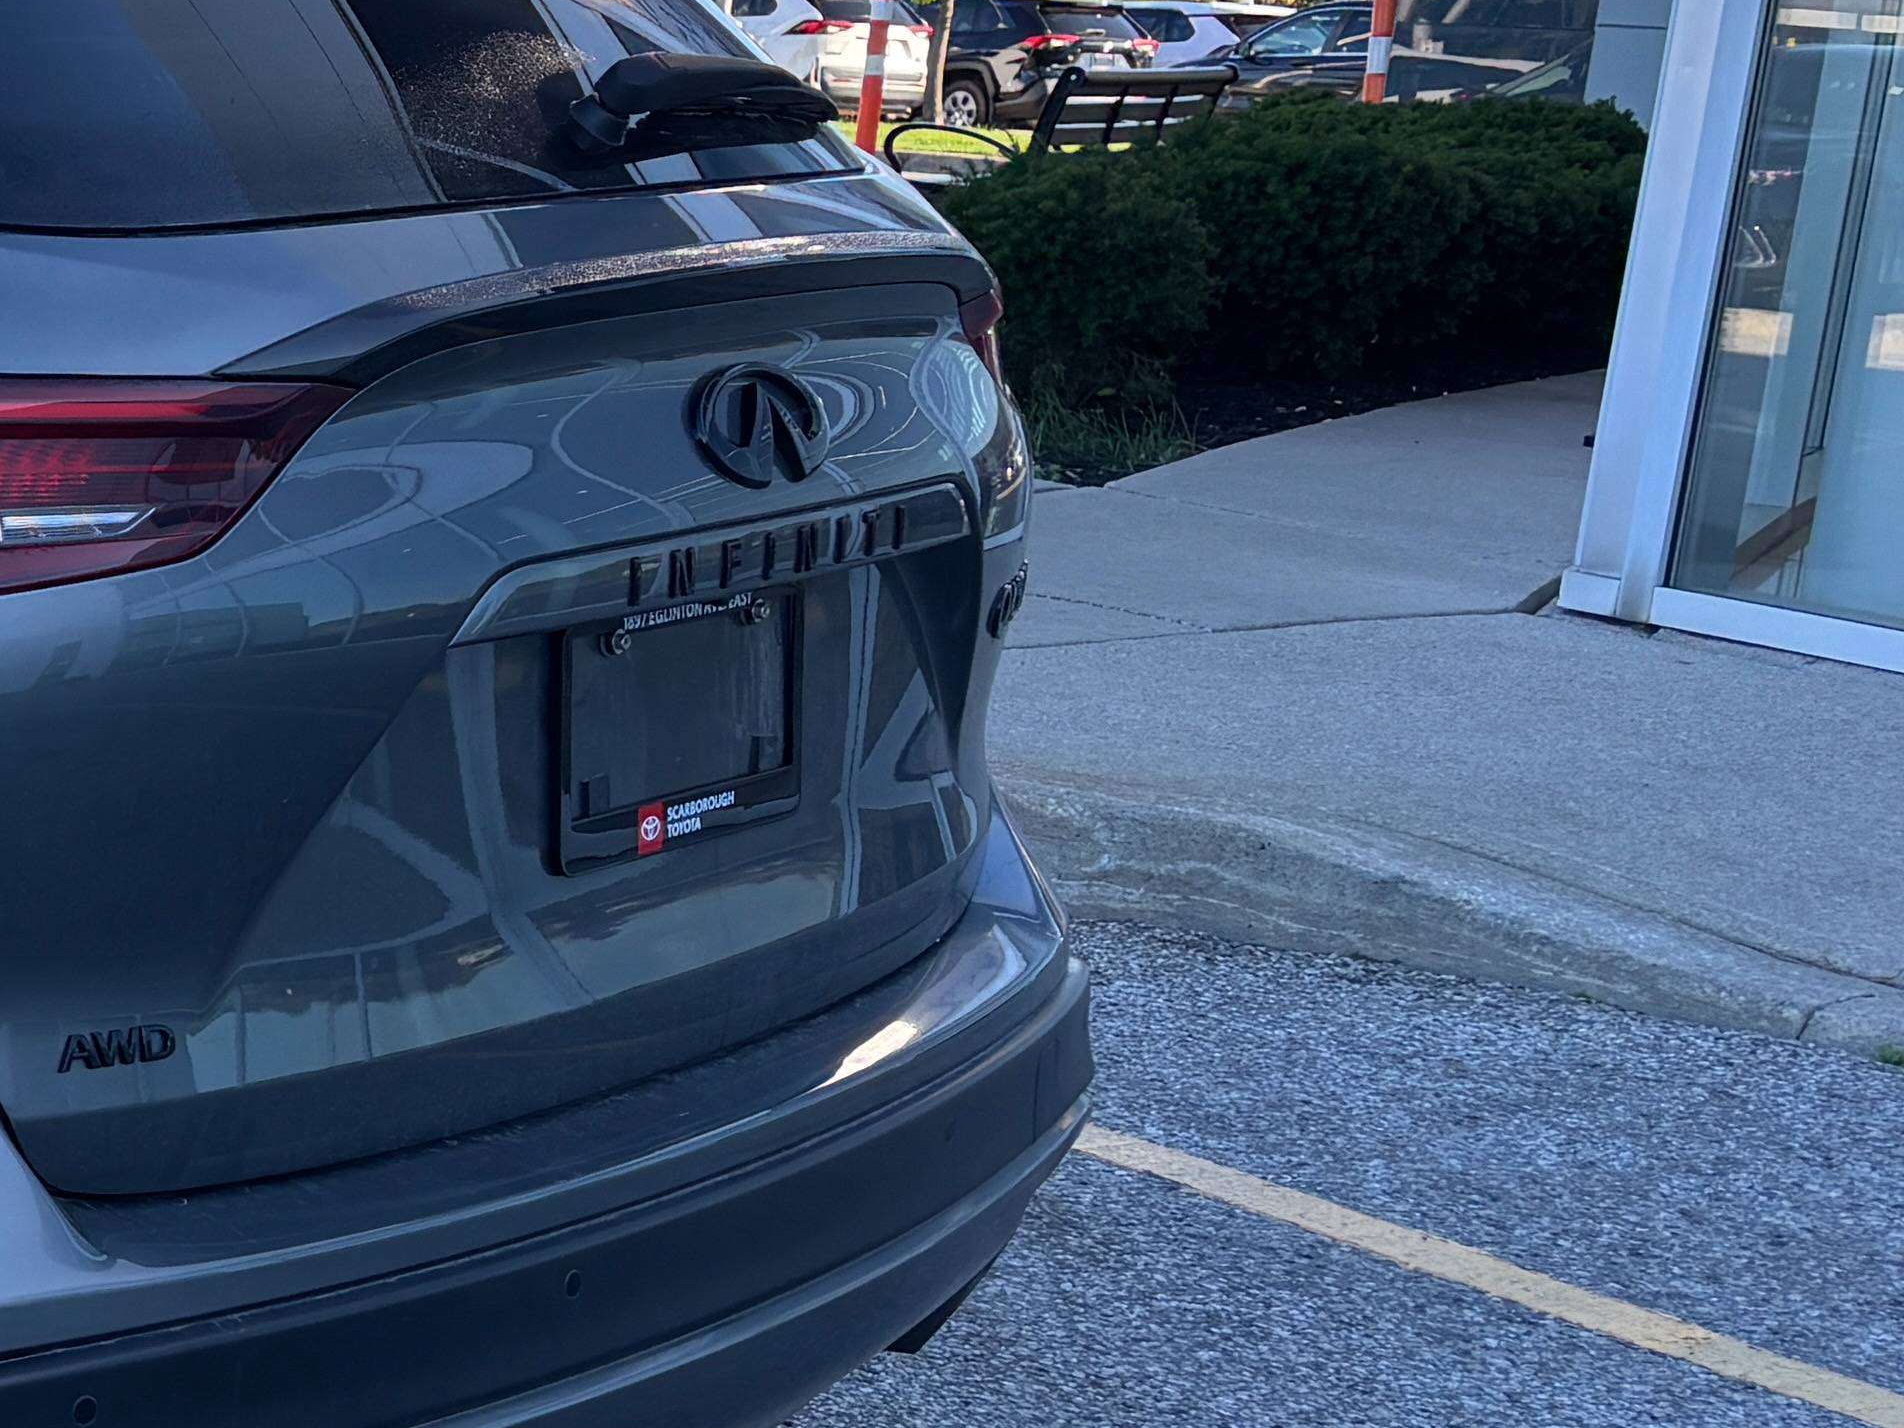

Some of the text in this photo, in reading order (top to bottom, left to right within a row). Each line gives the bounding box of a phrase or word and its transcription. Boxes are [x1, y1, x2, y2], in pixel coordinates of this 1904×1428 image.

[626, 504, 906, 607] INFINITI
[648, 603, 703, 625] EGLINTON
[667, 791, 735, 822] SCARBOROUGH
[667, 817, 702, 838] TOYOTA
[57, 1023, 176, 1074] AWD
